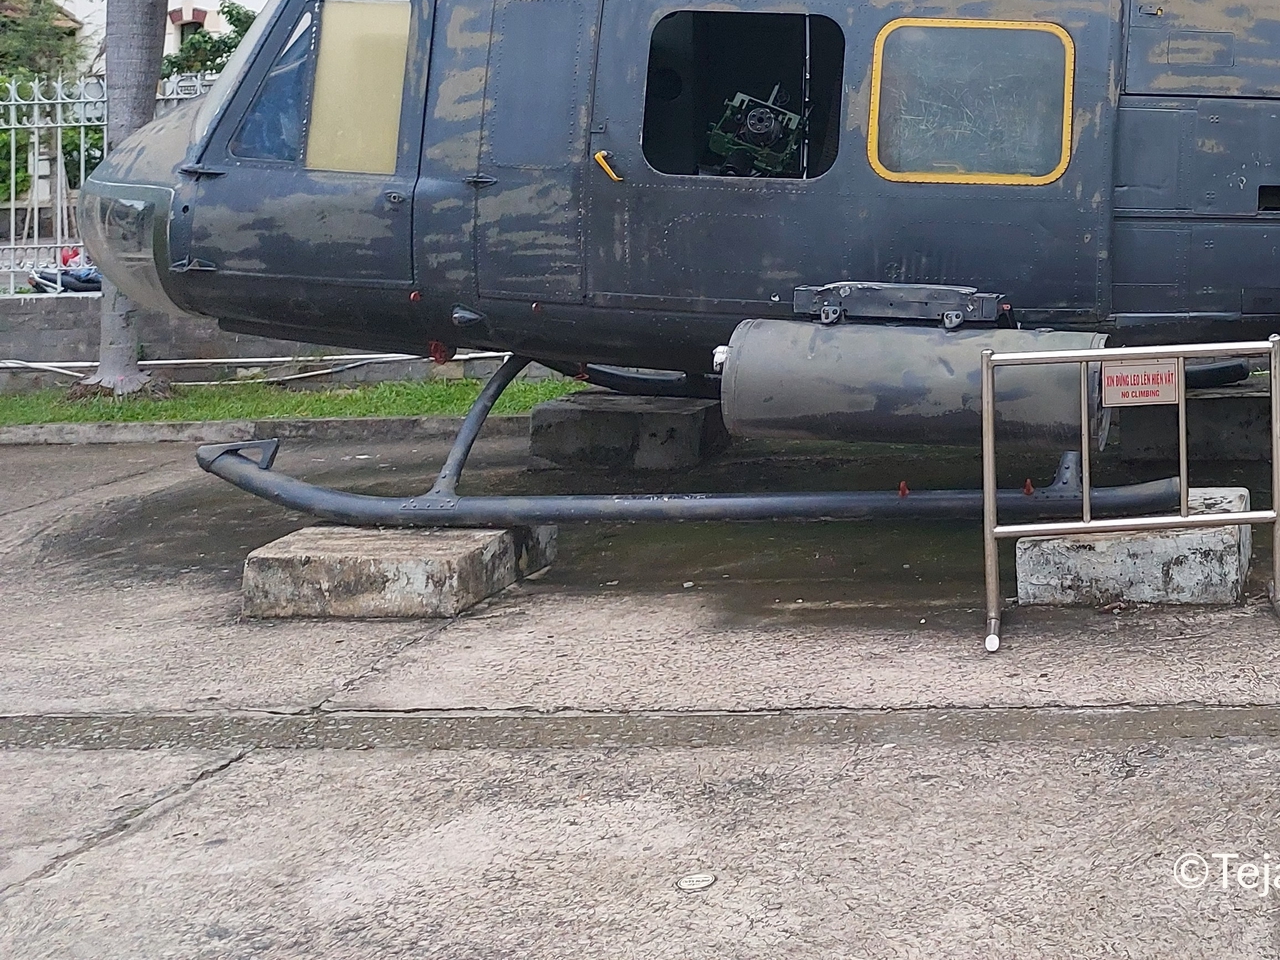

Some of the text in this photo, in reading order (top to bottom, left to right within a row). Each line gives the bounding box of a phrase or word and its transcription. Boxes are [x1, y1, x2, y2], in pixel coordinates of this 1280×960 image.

[1106, 370, 1174, 387] XIN ĐỪNG LEO LÊN HIỆN VẬT
[1121, 389, 1160, 399] NO CLIMBING
